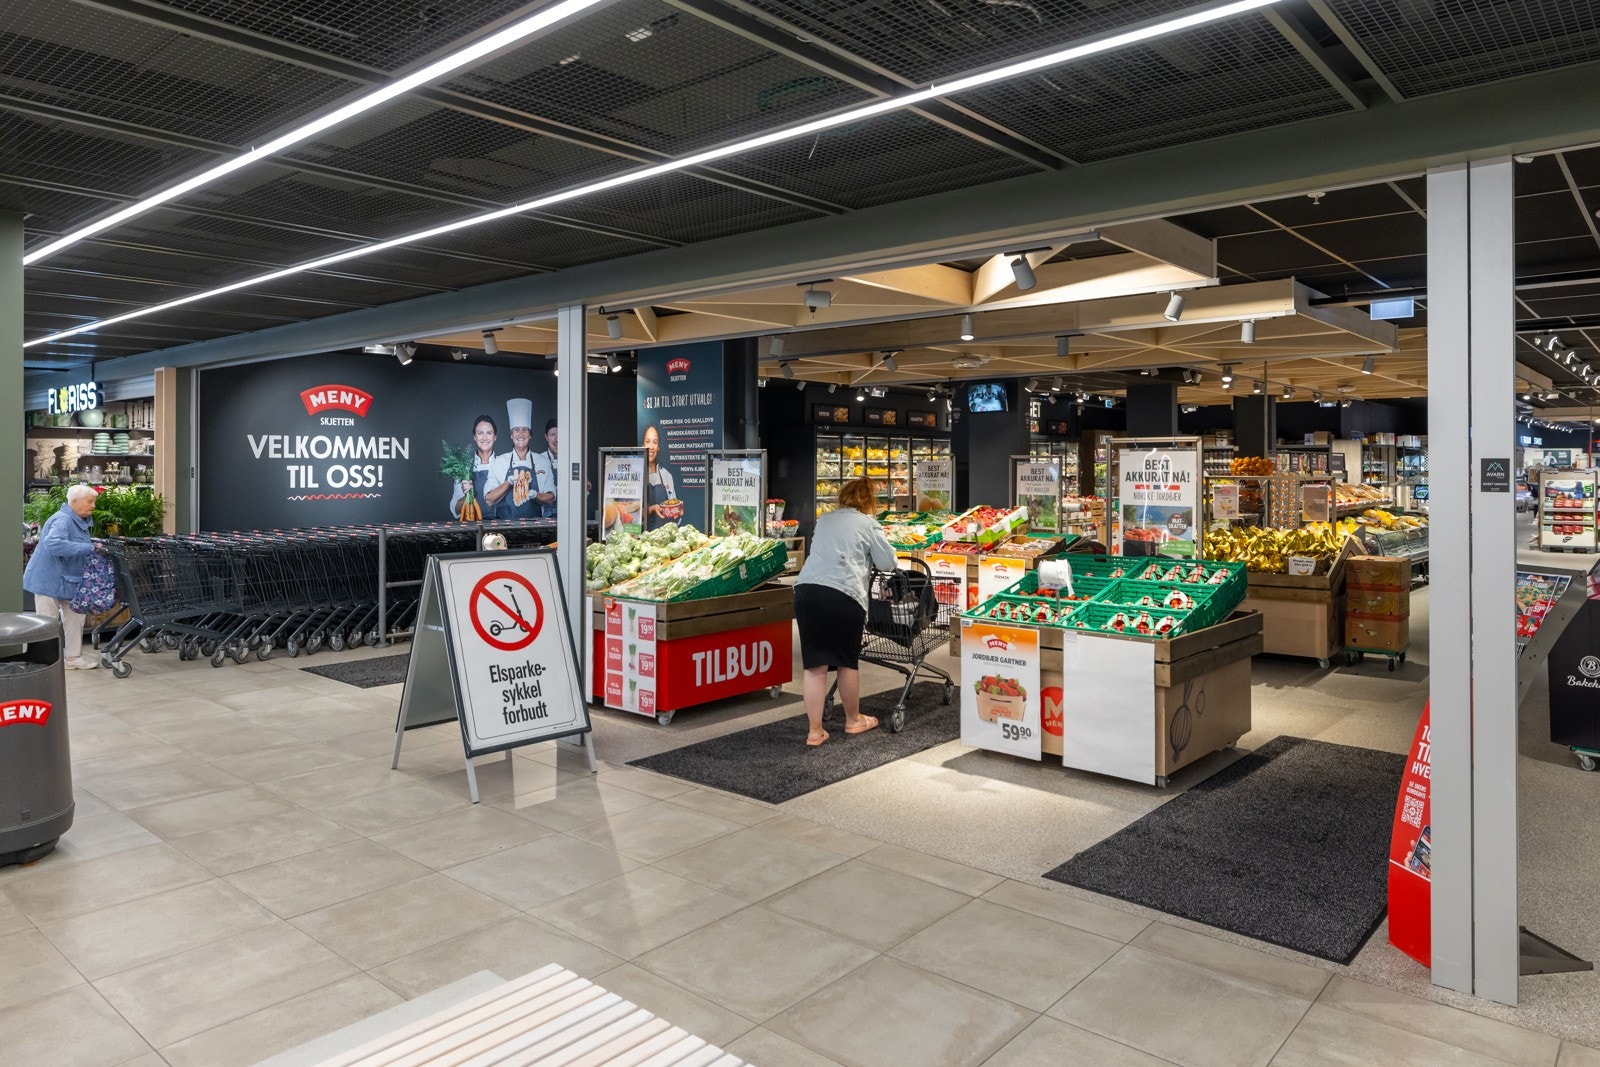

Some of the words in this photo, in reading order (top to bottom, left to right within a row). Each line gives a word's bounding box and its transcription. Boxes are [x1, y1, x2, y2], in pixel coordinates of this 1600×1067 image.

[669, 361, 688, 370] MENY
[48, 381, 97, 414] FLORISS
[309, 390, 366, 408] MENY
[661, 396, 671, 407] TIL
[672, 394, 688, 407] STORT
[320, 417, 354, 426] SKJETTEN
[247, 434, 409, 460] VELKOMMEN
[618, 464, 631, 472] BEST
[1145, 460, 1170, 470] BEST
[287, 465, 318, 488] TIL
[326, 464, 384, 488] OSS!
[608, 473, 630, 481] AKKURAT
[728, 468, 743, 476] BEST
[1125, 471, 1170, 482] AKKURAT
[1172, 470, 1190, 482] NÅ!
[716, 478, 743, 486] AKKURAT
[745, 477, 755, 487] NÅ!
[1134, 492, 1154, 500] NORSKE
[1156, 492, 1182, 501] JORDBÆR
[692, 640, 773, 687] TILBUD
[972, 653, 998, 662] JORDBÆR
[1000, 657, 1026, 666] GARTNER
[1587, 661, 1596, 670] B
[489, 660, 546, 685] Elsparke-
[502, 680, 542, 706] sykkel
[0, 705, 46, 722] ENY
[503, 701, 548, 725] forbudt
[1044, 696, 1063, 719] M
